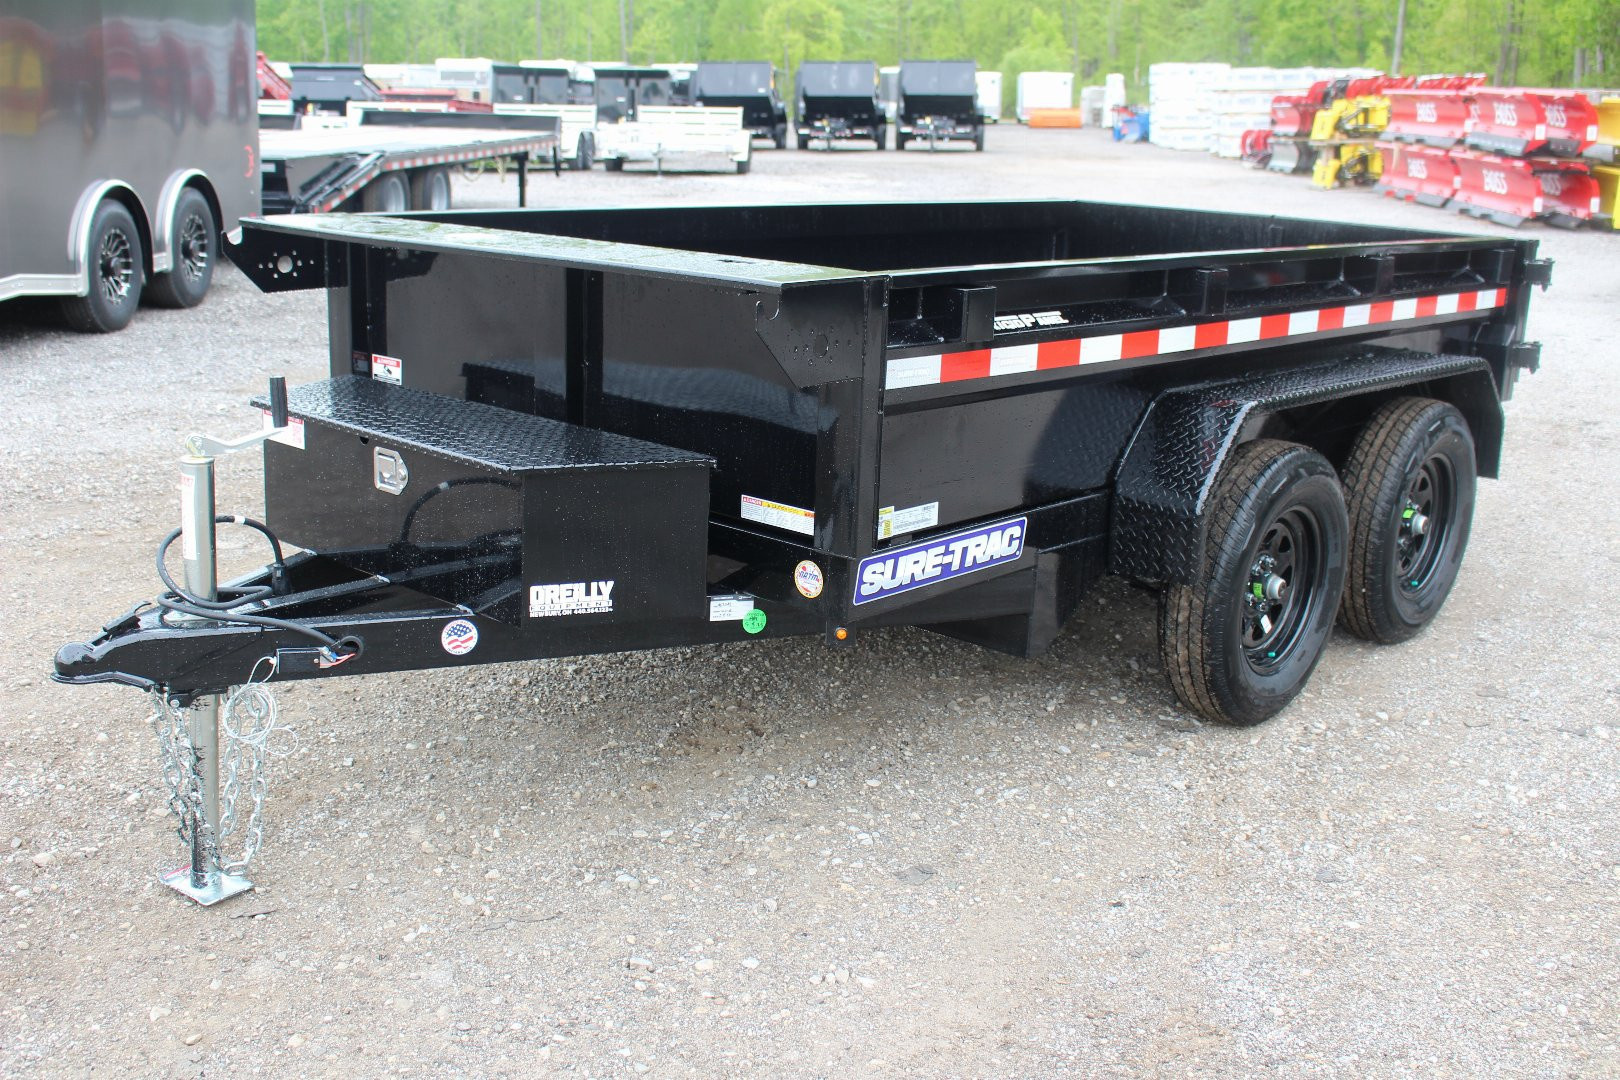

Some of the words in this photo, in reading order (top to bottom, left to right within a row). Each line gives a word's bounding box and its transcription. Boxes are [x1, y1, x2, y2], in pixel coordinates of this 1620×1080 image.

[1417, 103, 1437, 123] BOSS
[1494, 103, 1517, 126] BOSS
[1483, 170, 1507, 194] BOSS
[860, 525, 1020, 596] SURE-TRAC
[530, 601, 612, 611] EQUIPMENT
